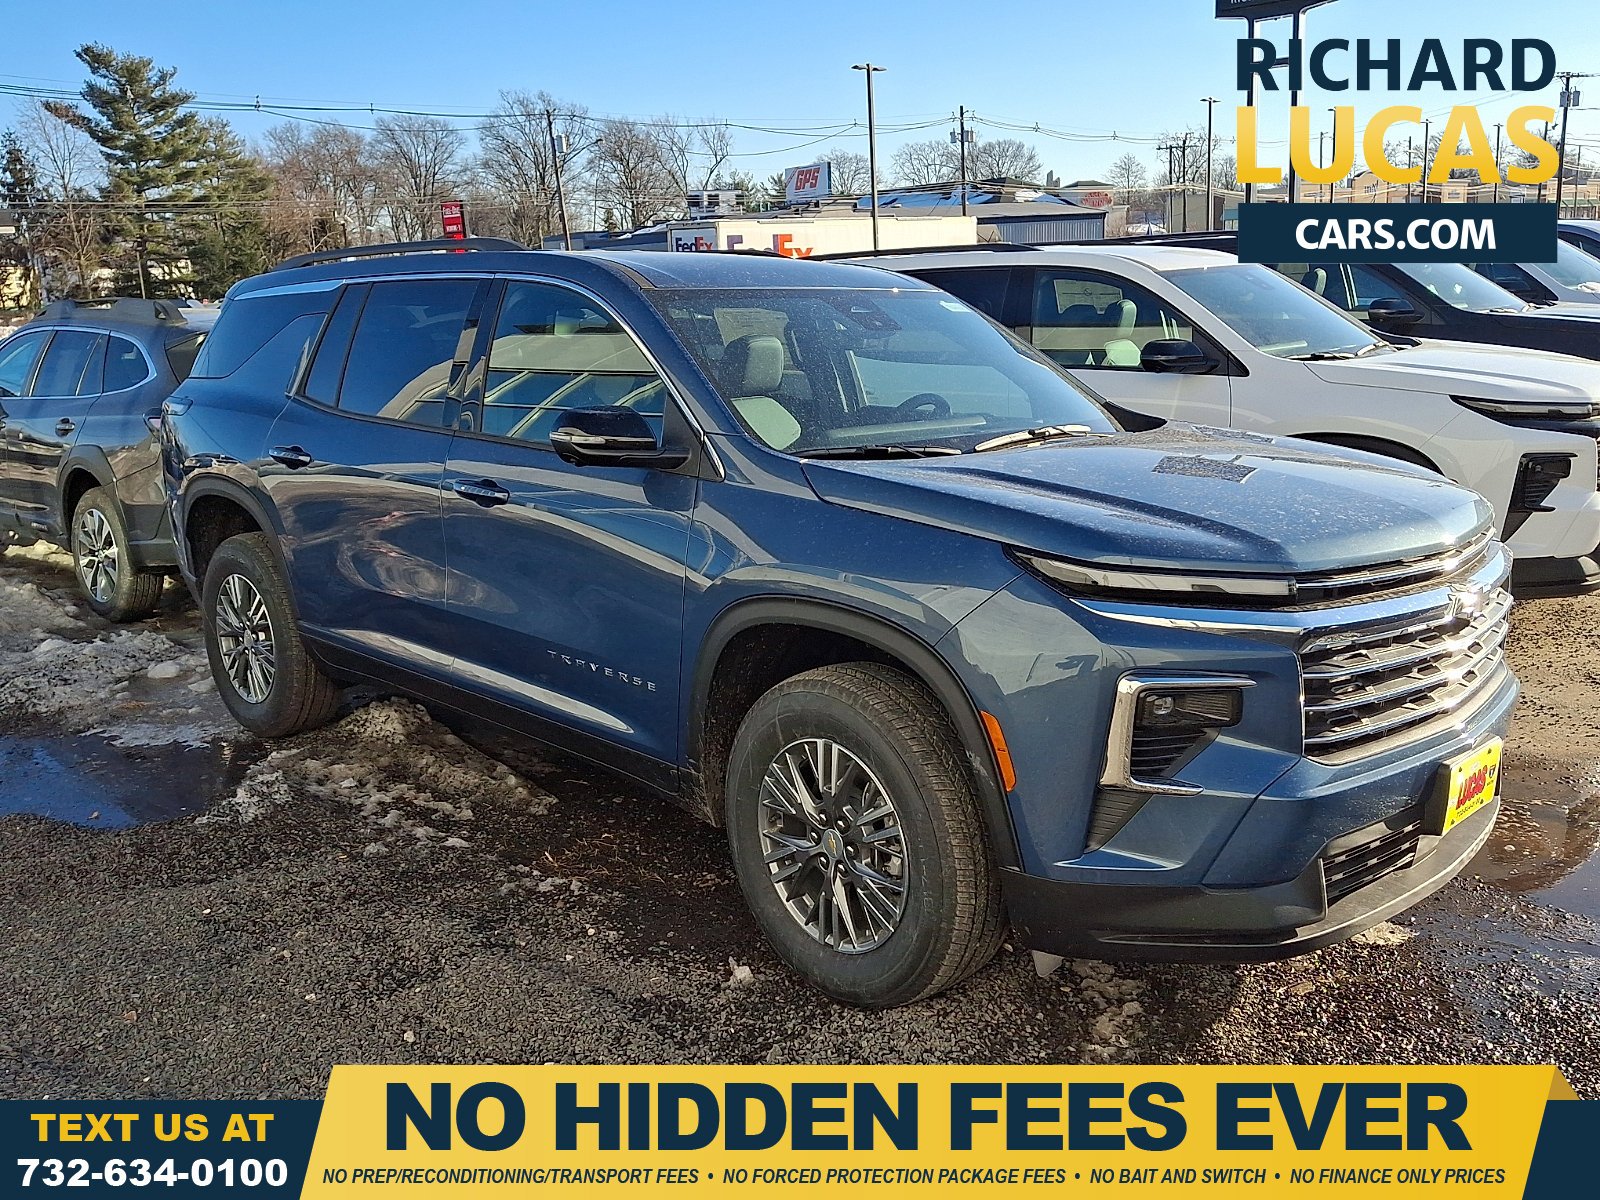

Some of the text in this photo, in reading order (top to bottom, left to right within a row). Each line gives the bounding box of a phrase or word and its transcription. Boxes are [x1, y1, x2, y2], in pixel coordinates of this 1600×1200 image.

[795, 167, 820, 190] GPS
[675, 237, 713, 251] FedEx
[727, 234, 813, 257] FEx
[547, 649, 656, 692] TRAVERSE
